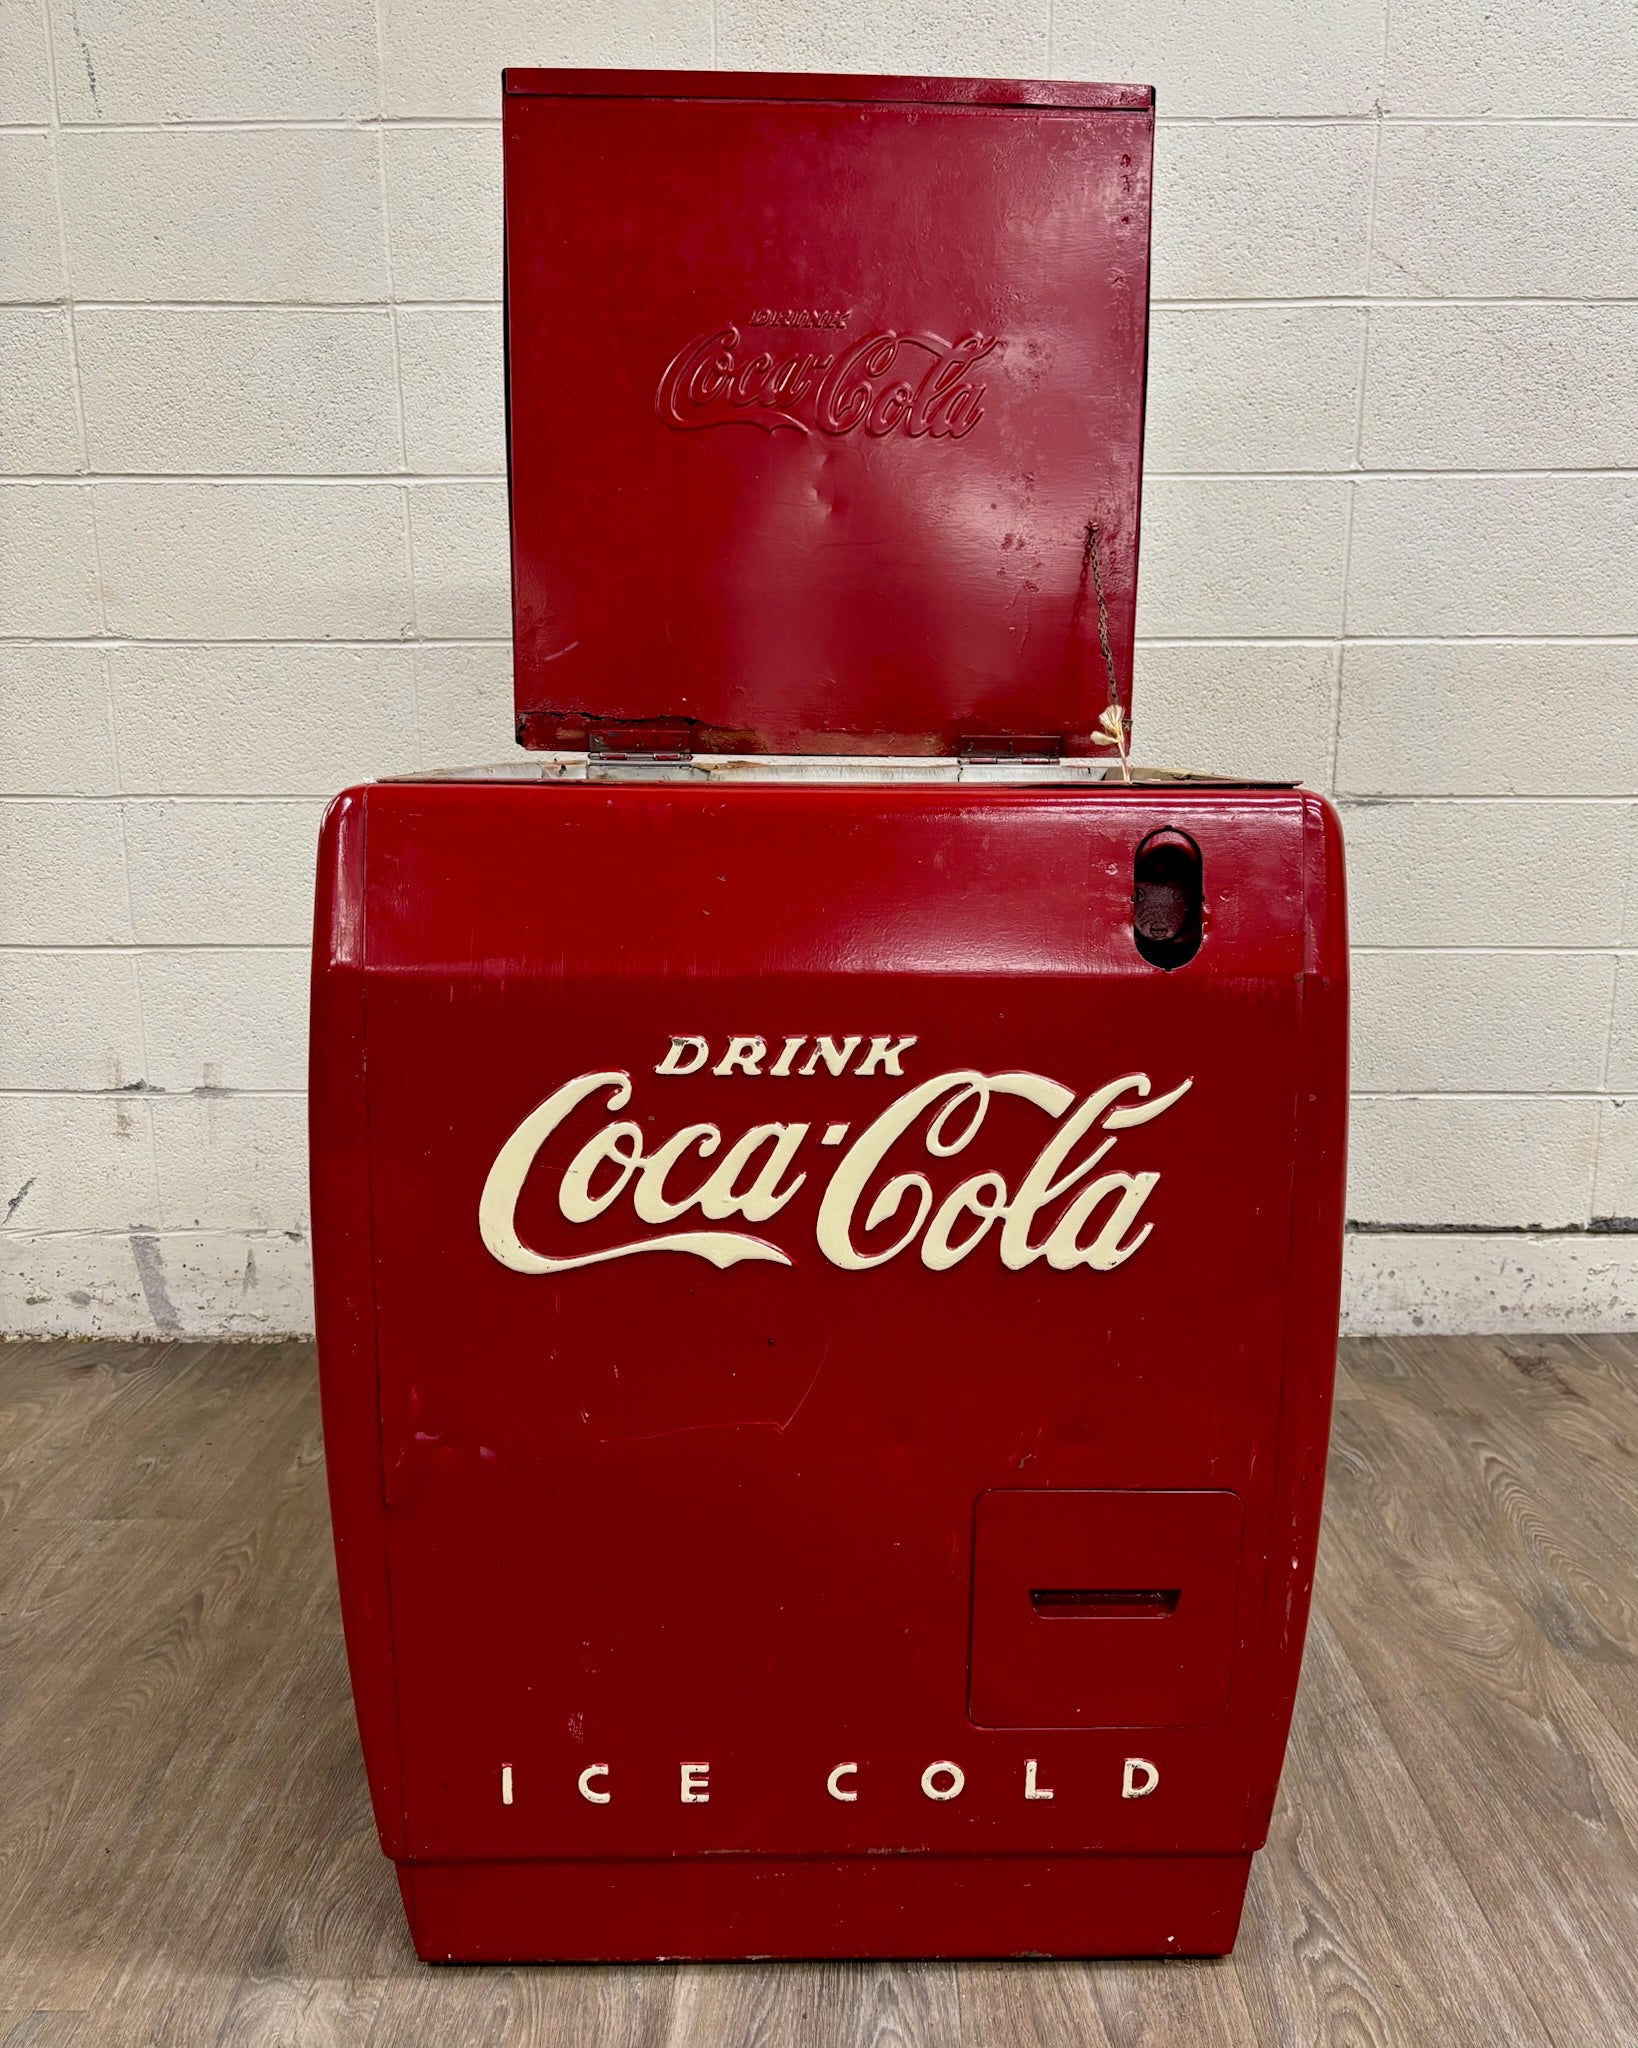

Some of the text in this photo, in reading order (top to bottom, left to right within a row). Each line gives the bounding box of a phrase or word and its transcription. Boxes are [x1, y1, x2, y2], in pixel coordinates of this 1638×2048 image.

[749, 308, 854, 330] DRINK
[655, 323, 1006, 440] Coca-Cola
[654, 1034, 918, 1076] DRINK
[478, 1069, 1195, 1274] Coca-Cola
[501, 1758, 1160, 1805] ICE COLD
